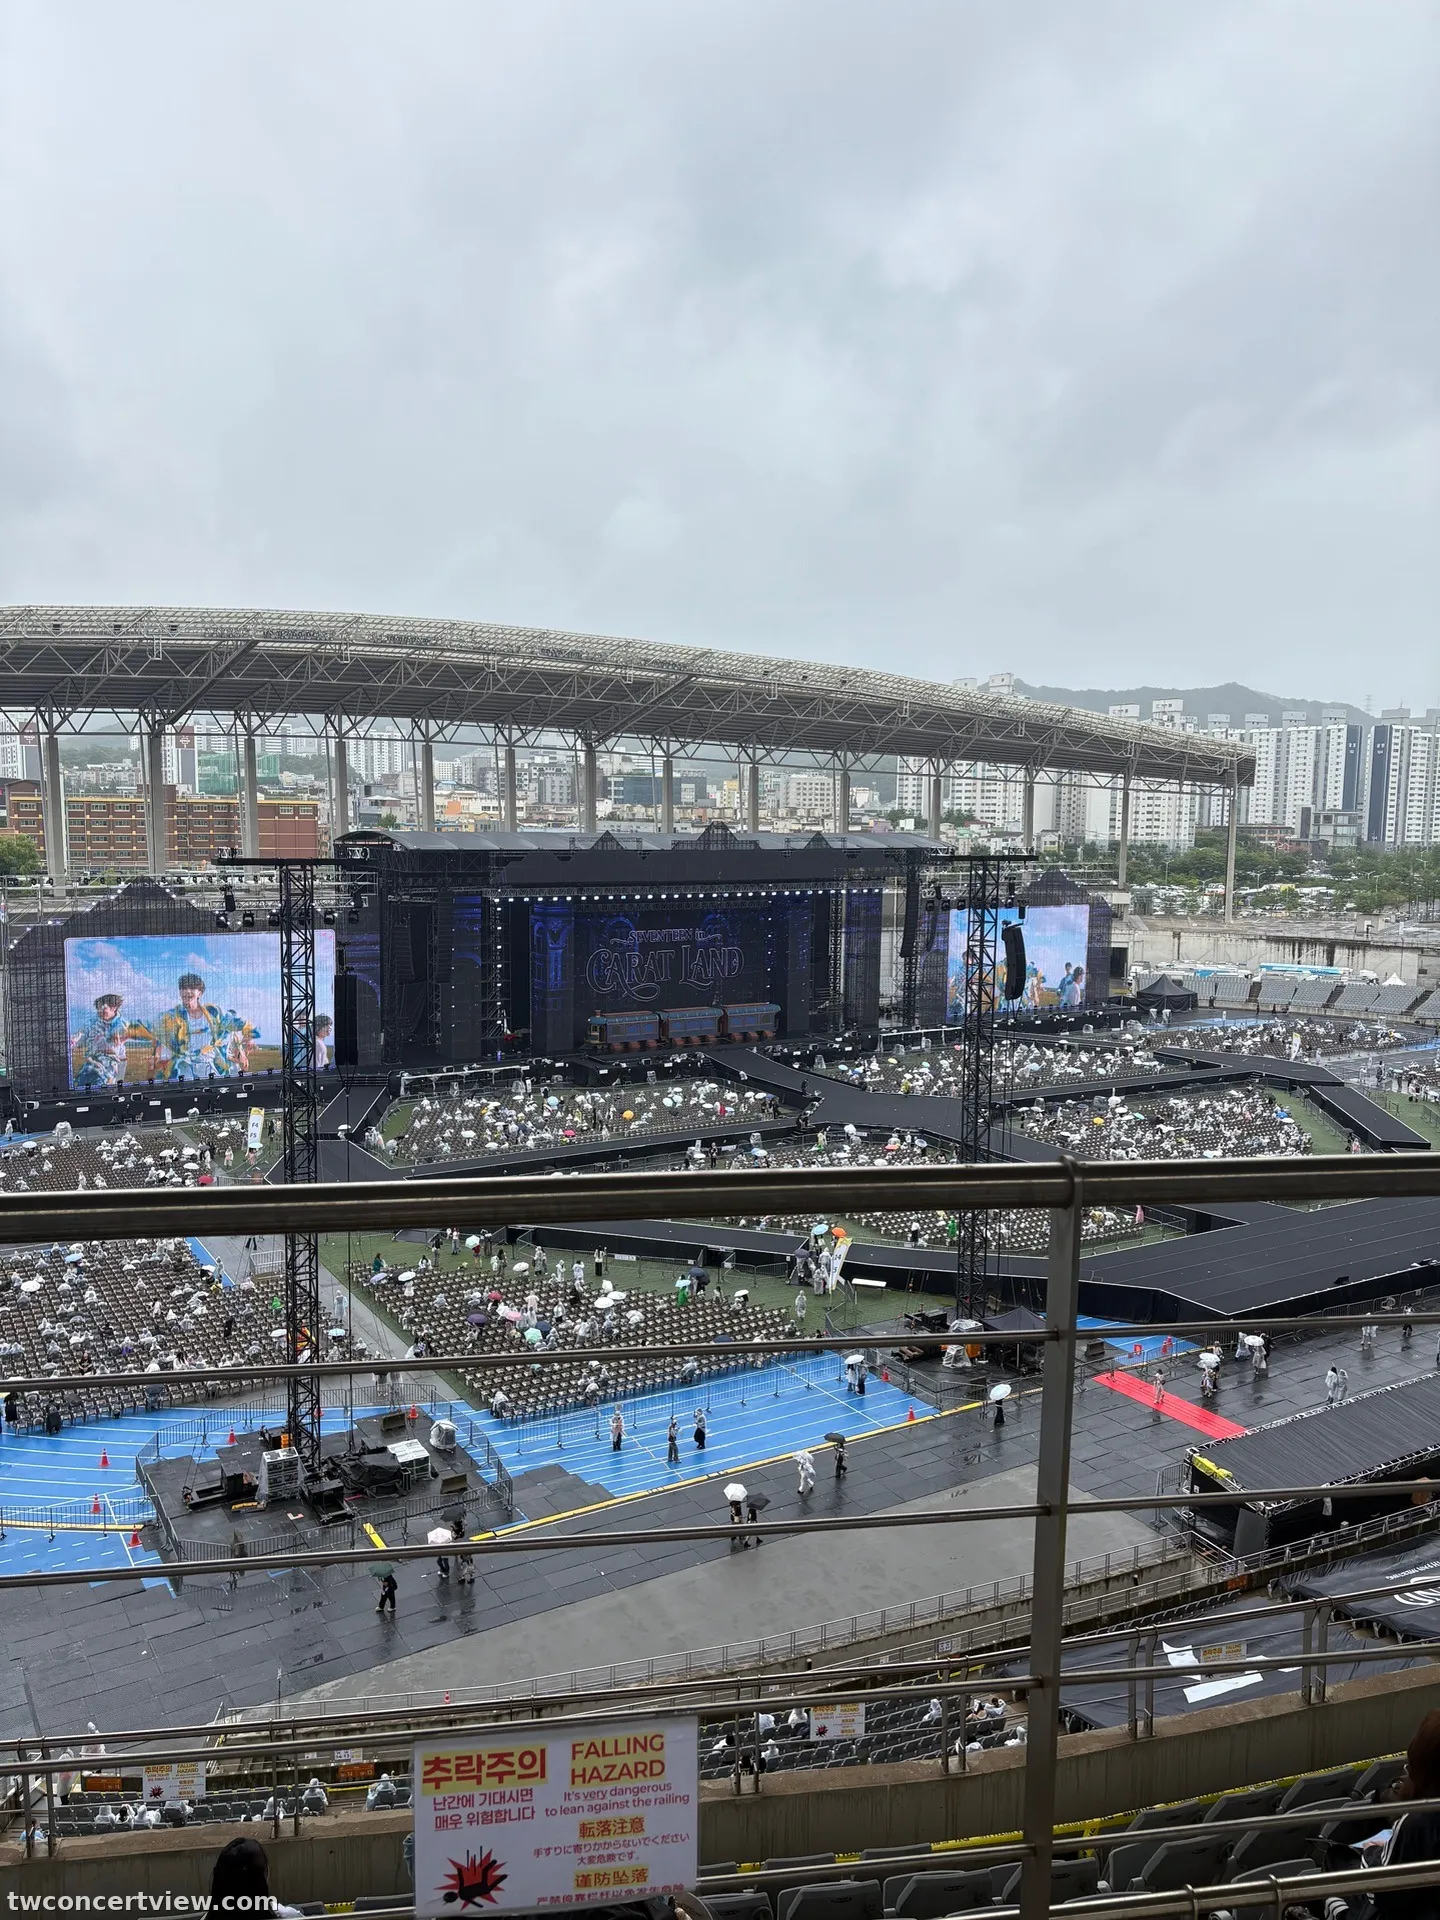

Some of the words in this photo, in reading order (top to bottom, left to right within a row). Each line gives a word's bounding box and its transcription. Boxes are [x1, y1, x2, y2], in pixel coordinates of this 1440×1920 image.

[628, 928, 694, 944] SEVENTEEN
[586, 948, 676, 1002] CARAT
[678, 944, 745, 991] LAND
[571, 1734, 665, 1761] FALLING
[422, 1748, 546, 1790] 추락주의
[570, 1759, 665, 1785] HAZARD
[433, 1793, 475, 1811] 난간에
[478, 1787, 534, 1807] 기대시면
[563, 1790, 580, 1802] It's
[582, 1788, 608, 1801] very
[609, 1782, 672, 1797] dangerous
[545, 1807, 557, 1817] to
[560, 1804, 584, 1815] lean
[586, 1799, 630, 1815] against
[632, 1797, 652, 1808] the
[654, 1793, 690, 1806] railing
[434, 1813, 463, 1830] 매우
[466, 1806, 536, 1826] 위험합니다
[578, 1816, 646, 1839] 転落注意
[533, 1832, 690, 1858] 手すりに寄りかからないでください
[574, 1867, 649, 1889] 谨防坠落
